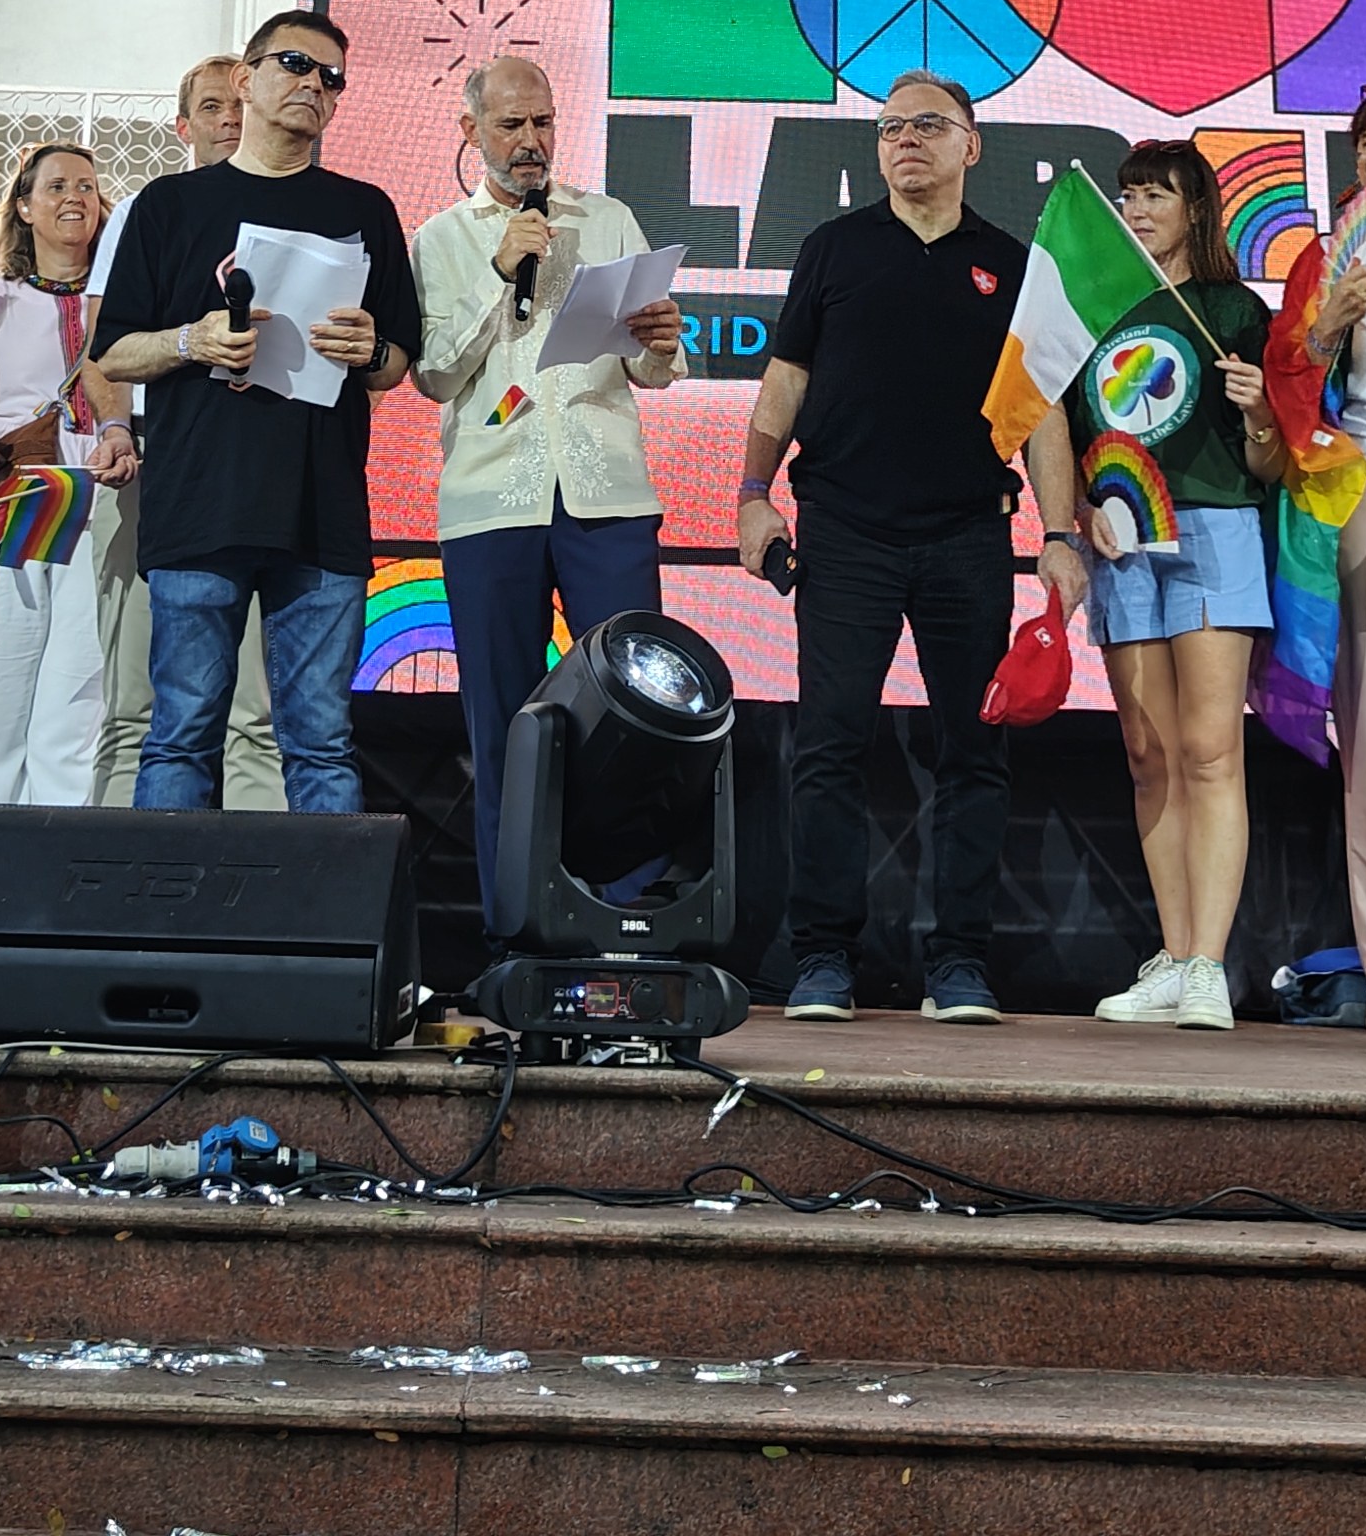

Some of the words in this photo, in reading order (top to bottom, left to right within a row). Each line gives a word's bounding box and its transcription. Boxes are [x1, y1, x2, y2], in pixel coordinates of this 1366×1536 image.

[679, 314, 769, 355] RID
[1151, 421, 1175, 440] the
[59, 859, 281, 907] FBT
